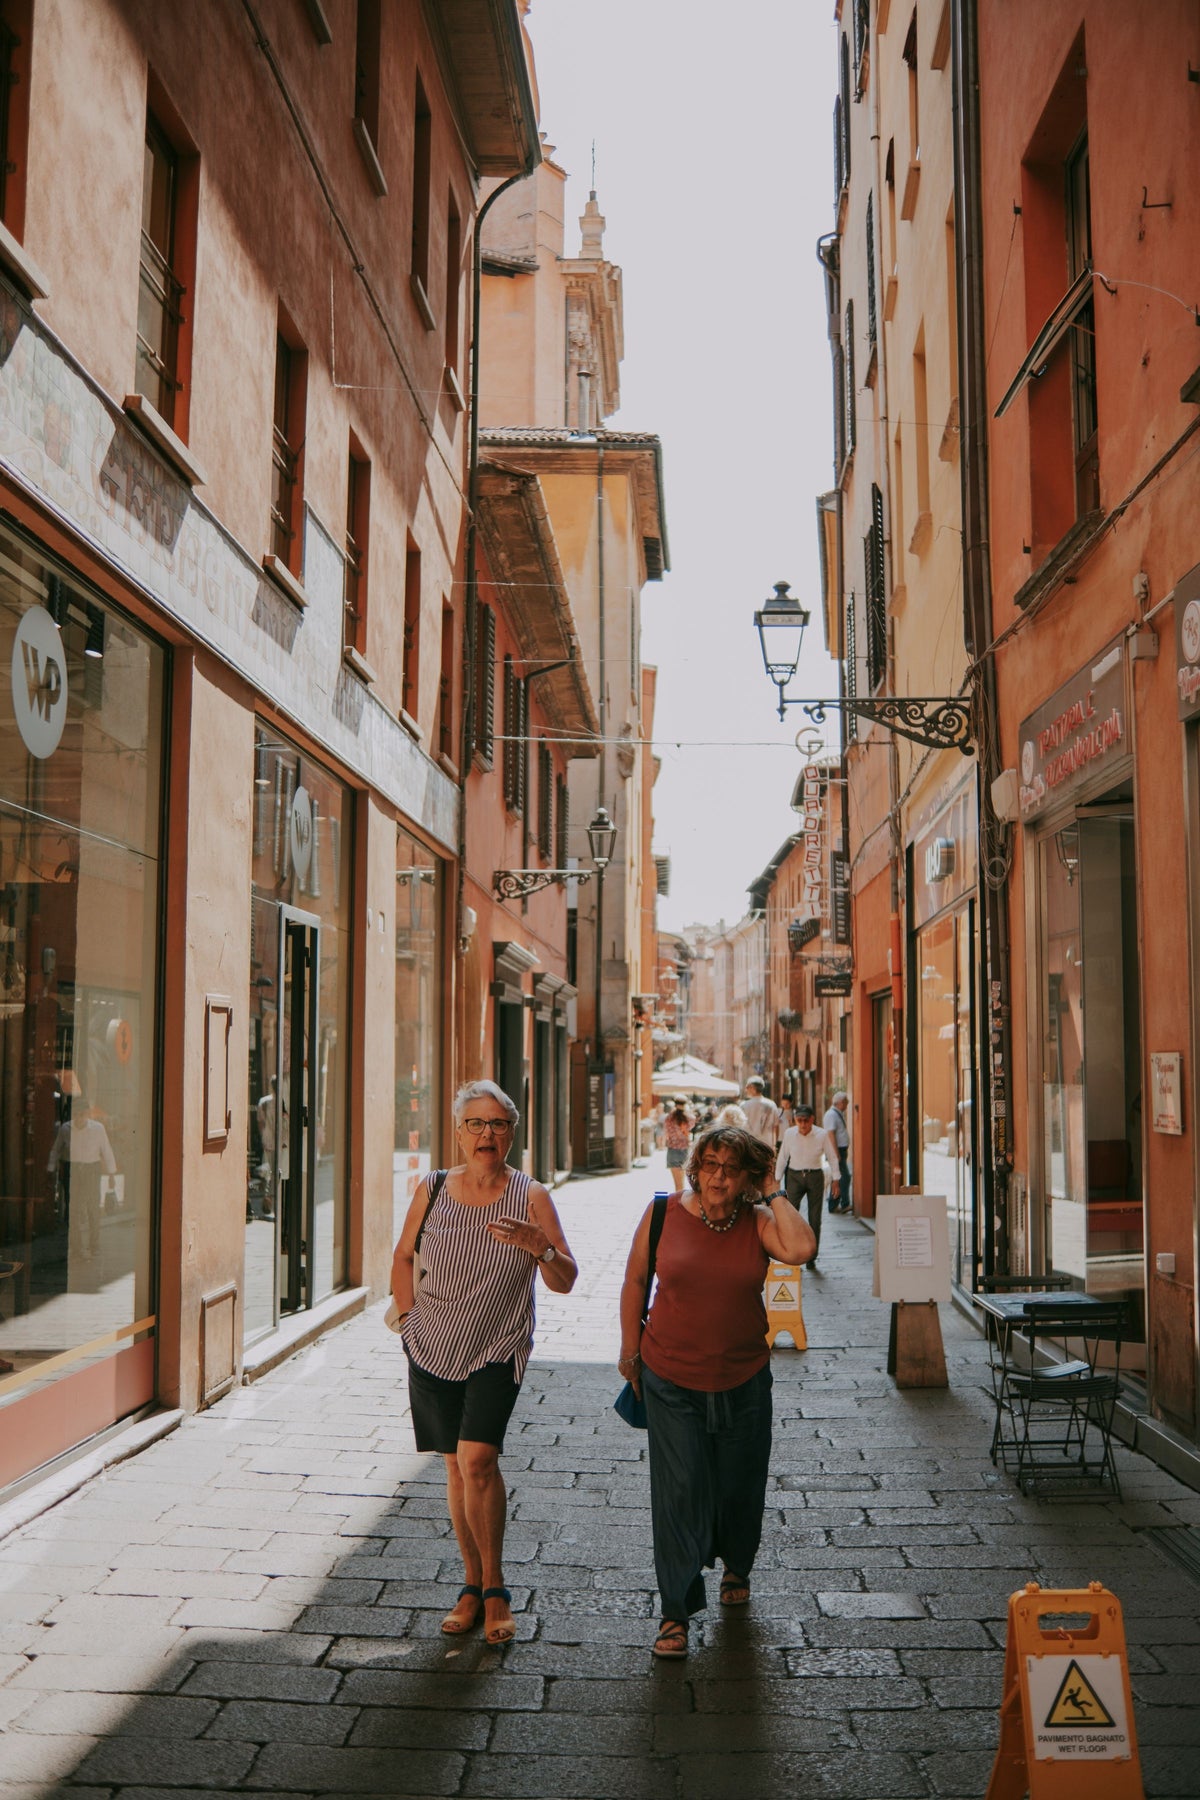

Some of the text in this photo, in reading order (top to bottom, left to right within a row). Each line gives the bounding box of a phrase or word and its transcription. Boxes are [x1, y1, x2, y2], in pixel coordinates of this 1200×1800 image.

[21, 639, 61, 724] WP
[1038, 1734, 1125, 1743] PAVIMENTO BAGNATO
[1058, 1745, 1107, 1753] WET FLOOR
